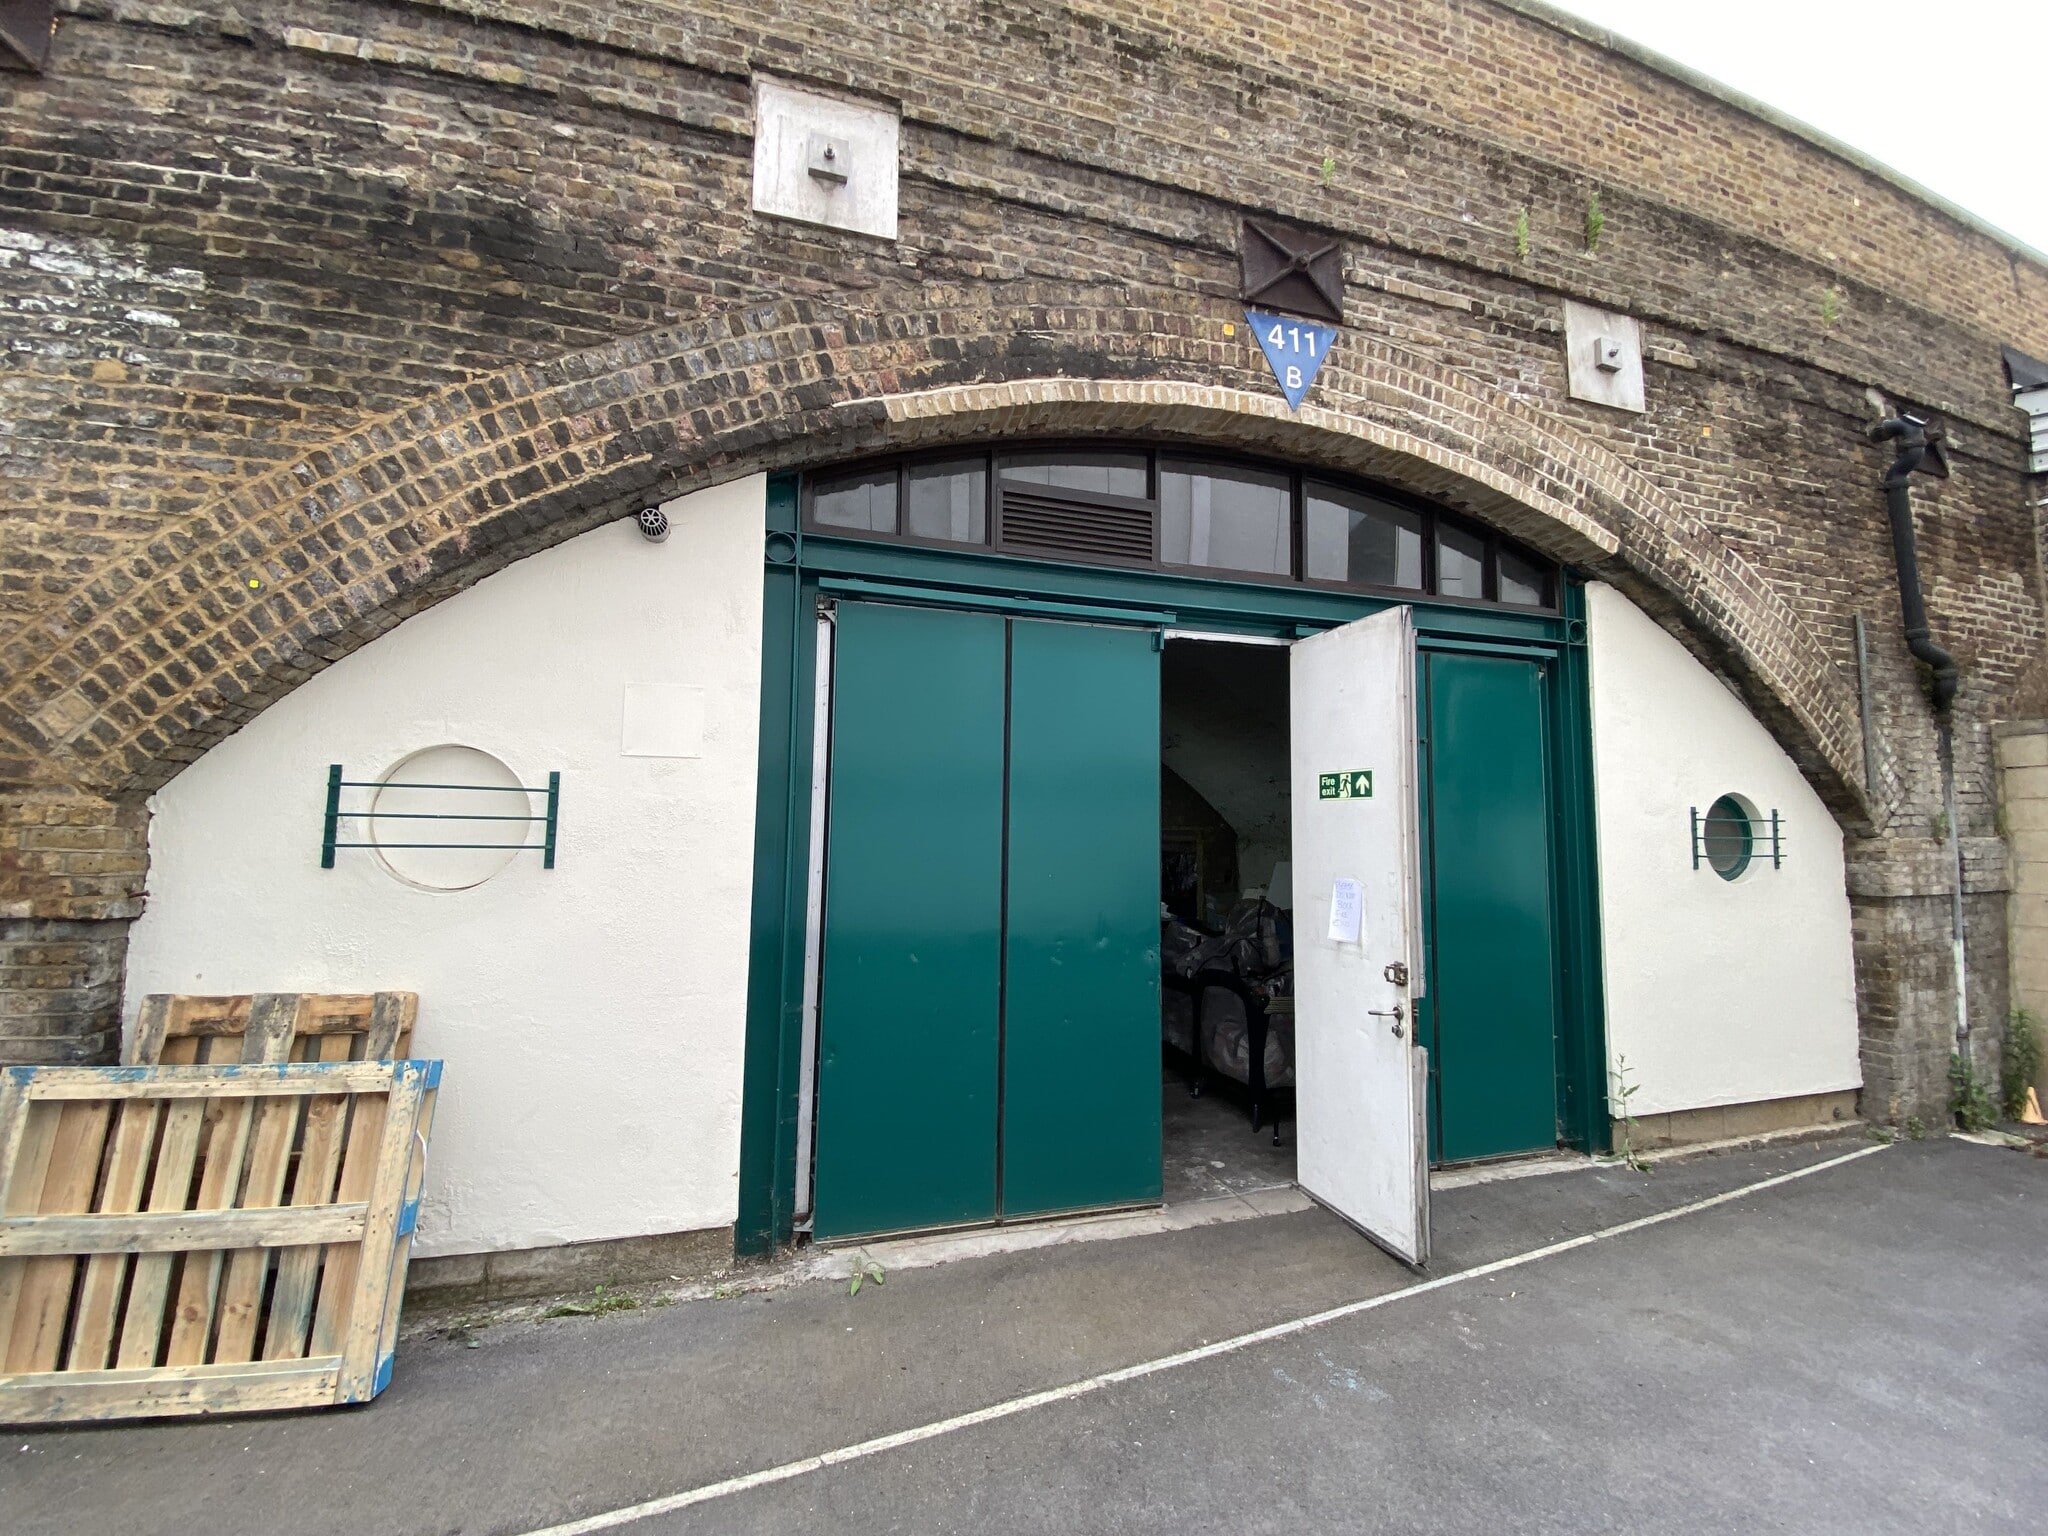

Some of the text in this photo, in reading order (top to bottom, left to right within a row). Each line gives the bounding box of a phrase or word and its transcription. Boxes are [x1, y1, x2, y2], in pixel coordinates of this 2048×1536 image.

[1267, 323, 1315, 358] 411
[1286, 365, 1303, 390] B
[1321, 776, 1336, 786] Fire
[1321, 786, 1336, 796] exit
